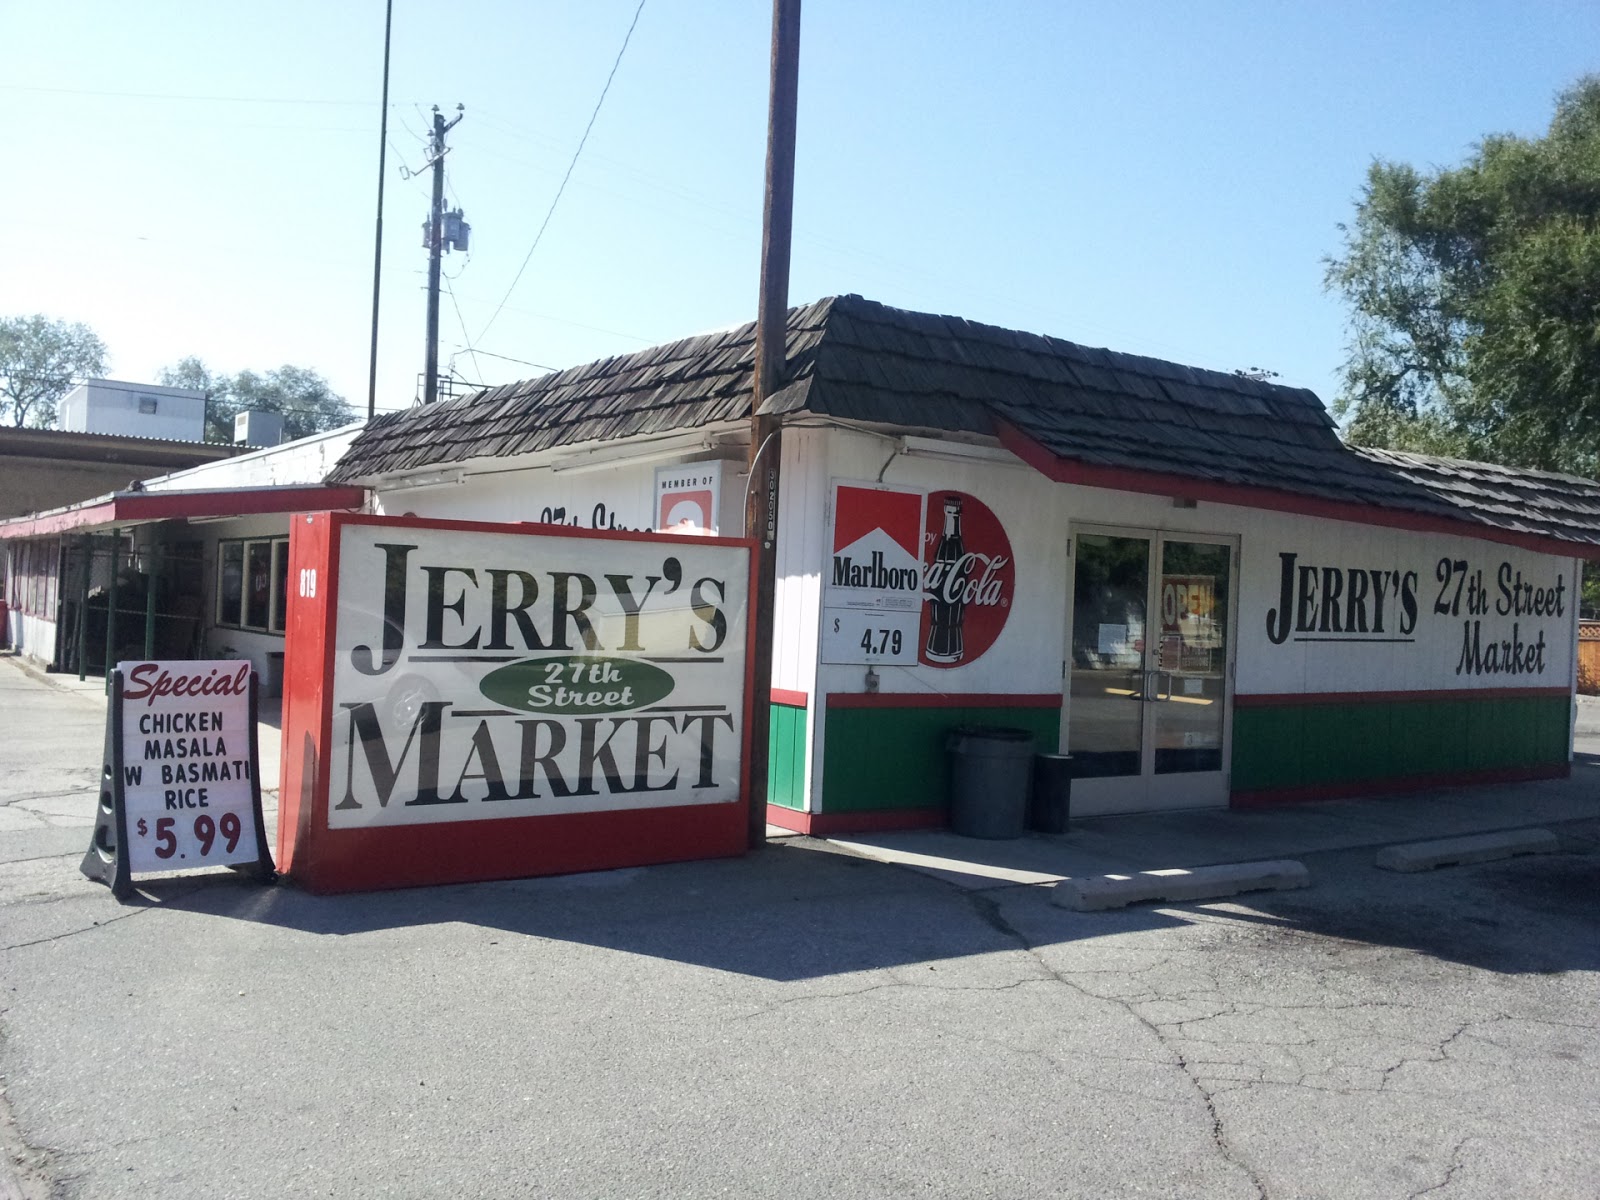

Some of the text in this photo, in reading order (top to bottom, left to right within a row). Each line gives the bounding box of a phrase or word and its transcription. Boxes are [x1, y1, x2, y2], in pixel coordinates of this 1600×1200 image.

[661, 475, 714, 489] MEMBER OF
[299, 568, 317, 598] 819
[831, 550, 918, 591] Marlboro
[1433, 557, 1566, 619] 27th Street
[350, 543, 728, 676] JERRY'S
[1163, 583, 1211, 625] OPEN
[1265, 552, 1419, 645] JERRY'S
[833, 617, 903, 655] $ 4.79
[1455, 620, 1546, 676] Market
[122, 663, 250, 707] Special
[543, 661, 623, 683] 27th
[526, 684, 636, 708] Street
[139, 711, 223, 735] CHICKEN
[144, 736, 227, 760] MASALA
[334, 700, 735, 810] MARKET
[124, 760, 250, 787] W BASMATI
[164, 788, 209, 810] RICE
